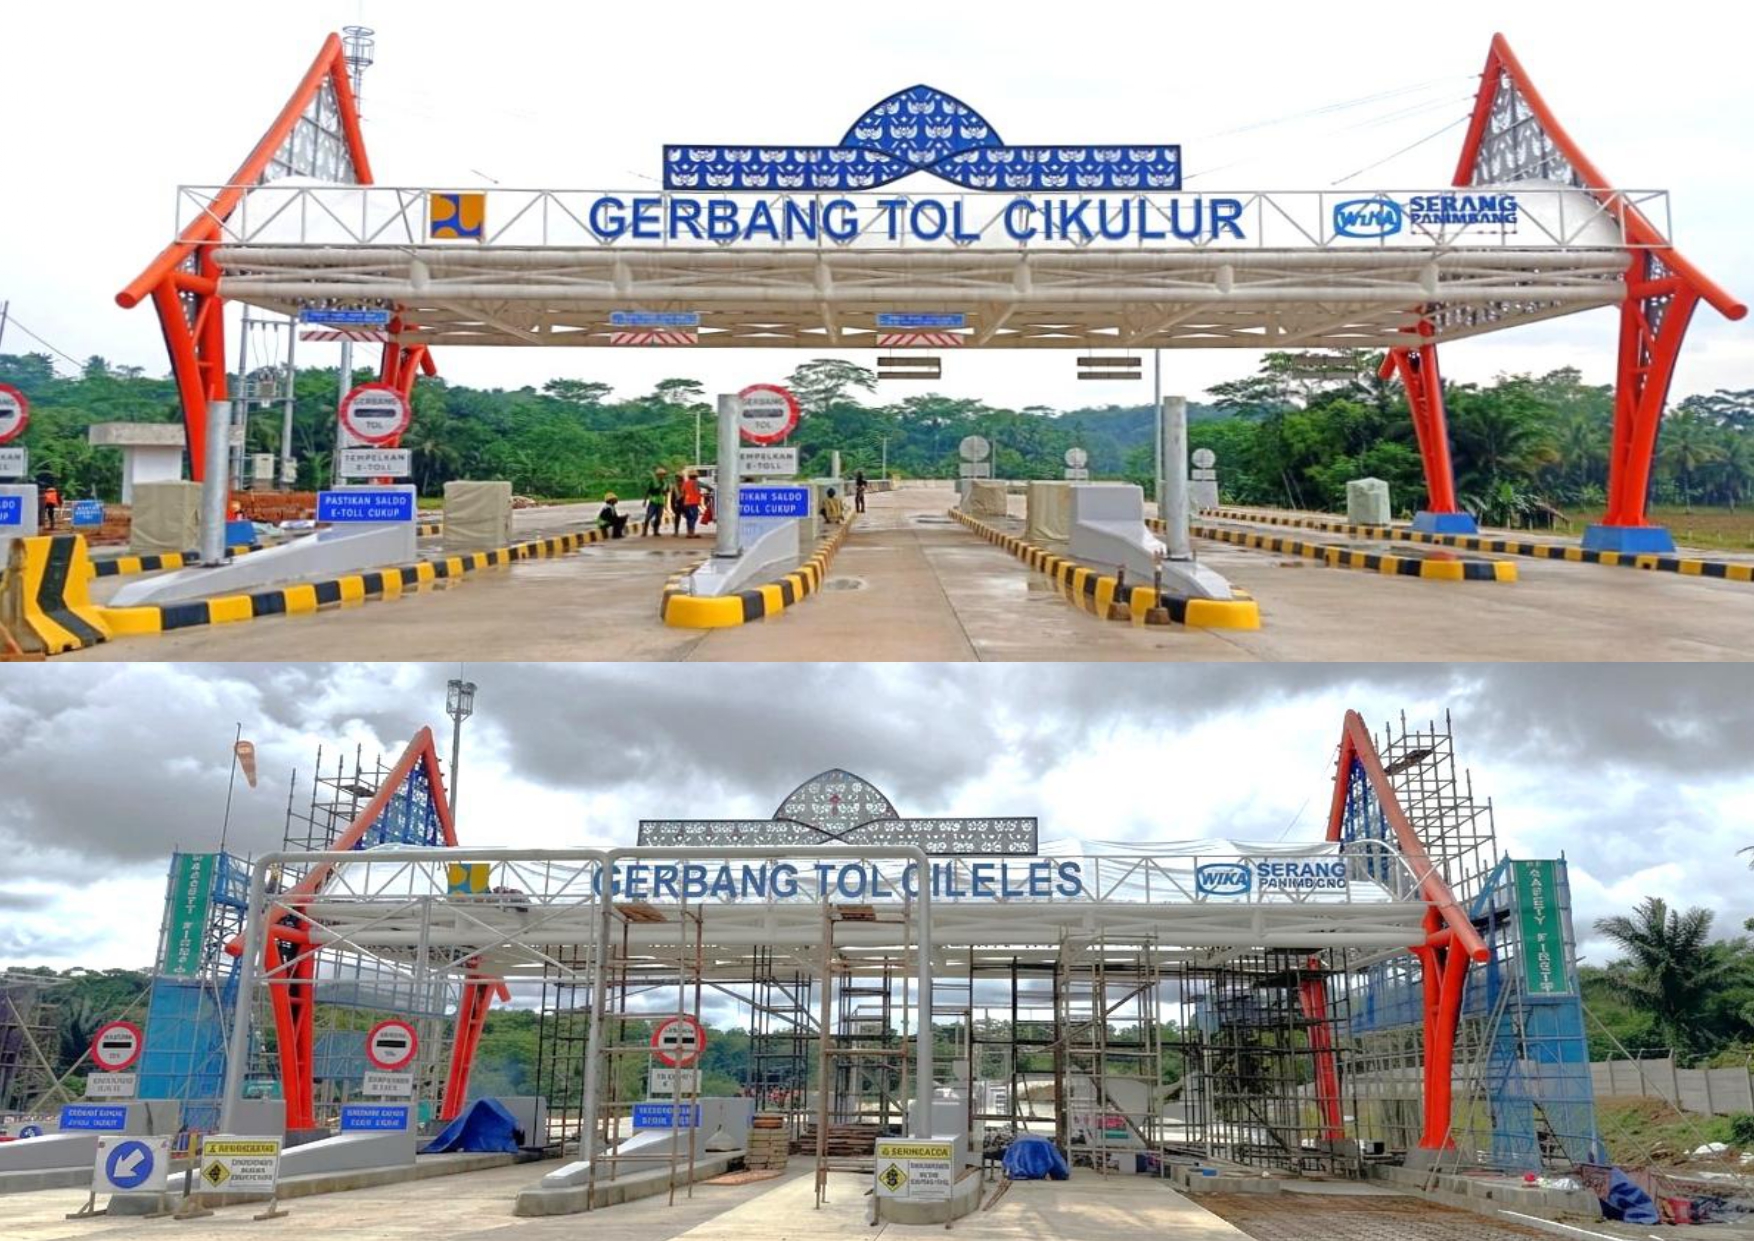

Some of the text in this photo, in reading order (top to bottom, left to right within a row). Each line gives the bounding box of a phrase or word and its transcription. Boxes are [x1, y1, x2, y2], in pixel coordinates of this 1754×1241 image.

[1409, 196, 1518, 212] SERANG
[589, 196, 1246, 241] GERBANG TOL CIKULUR
[345, 454, 405, 462] TEMPELKAN
[740, 453, 793, 461] EMPELKAN
[356, 463, 392, 471] E-TOLL
[325, 496, 407, 506] PASTIKAN SALDO
[771, 492, 802, 501] SALDO
[331, 508, 400, 518] E-TOLL CUKUP
[765, 504, 796, 514] CUKUP
[1257, 862, 1347, 878] SERANG
[593, 861, 1083, 899] GERBANG TOL CILELES
[1202, 872, 1248, 887] WIKA
